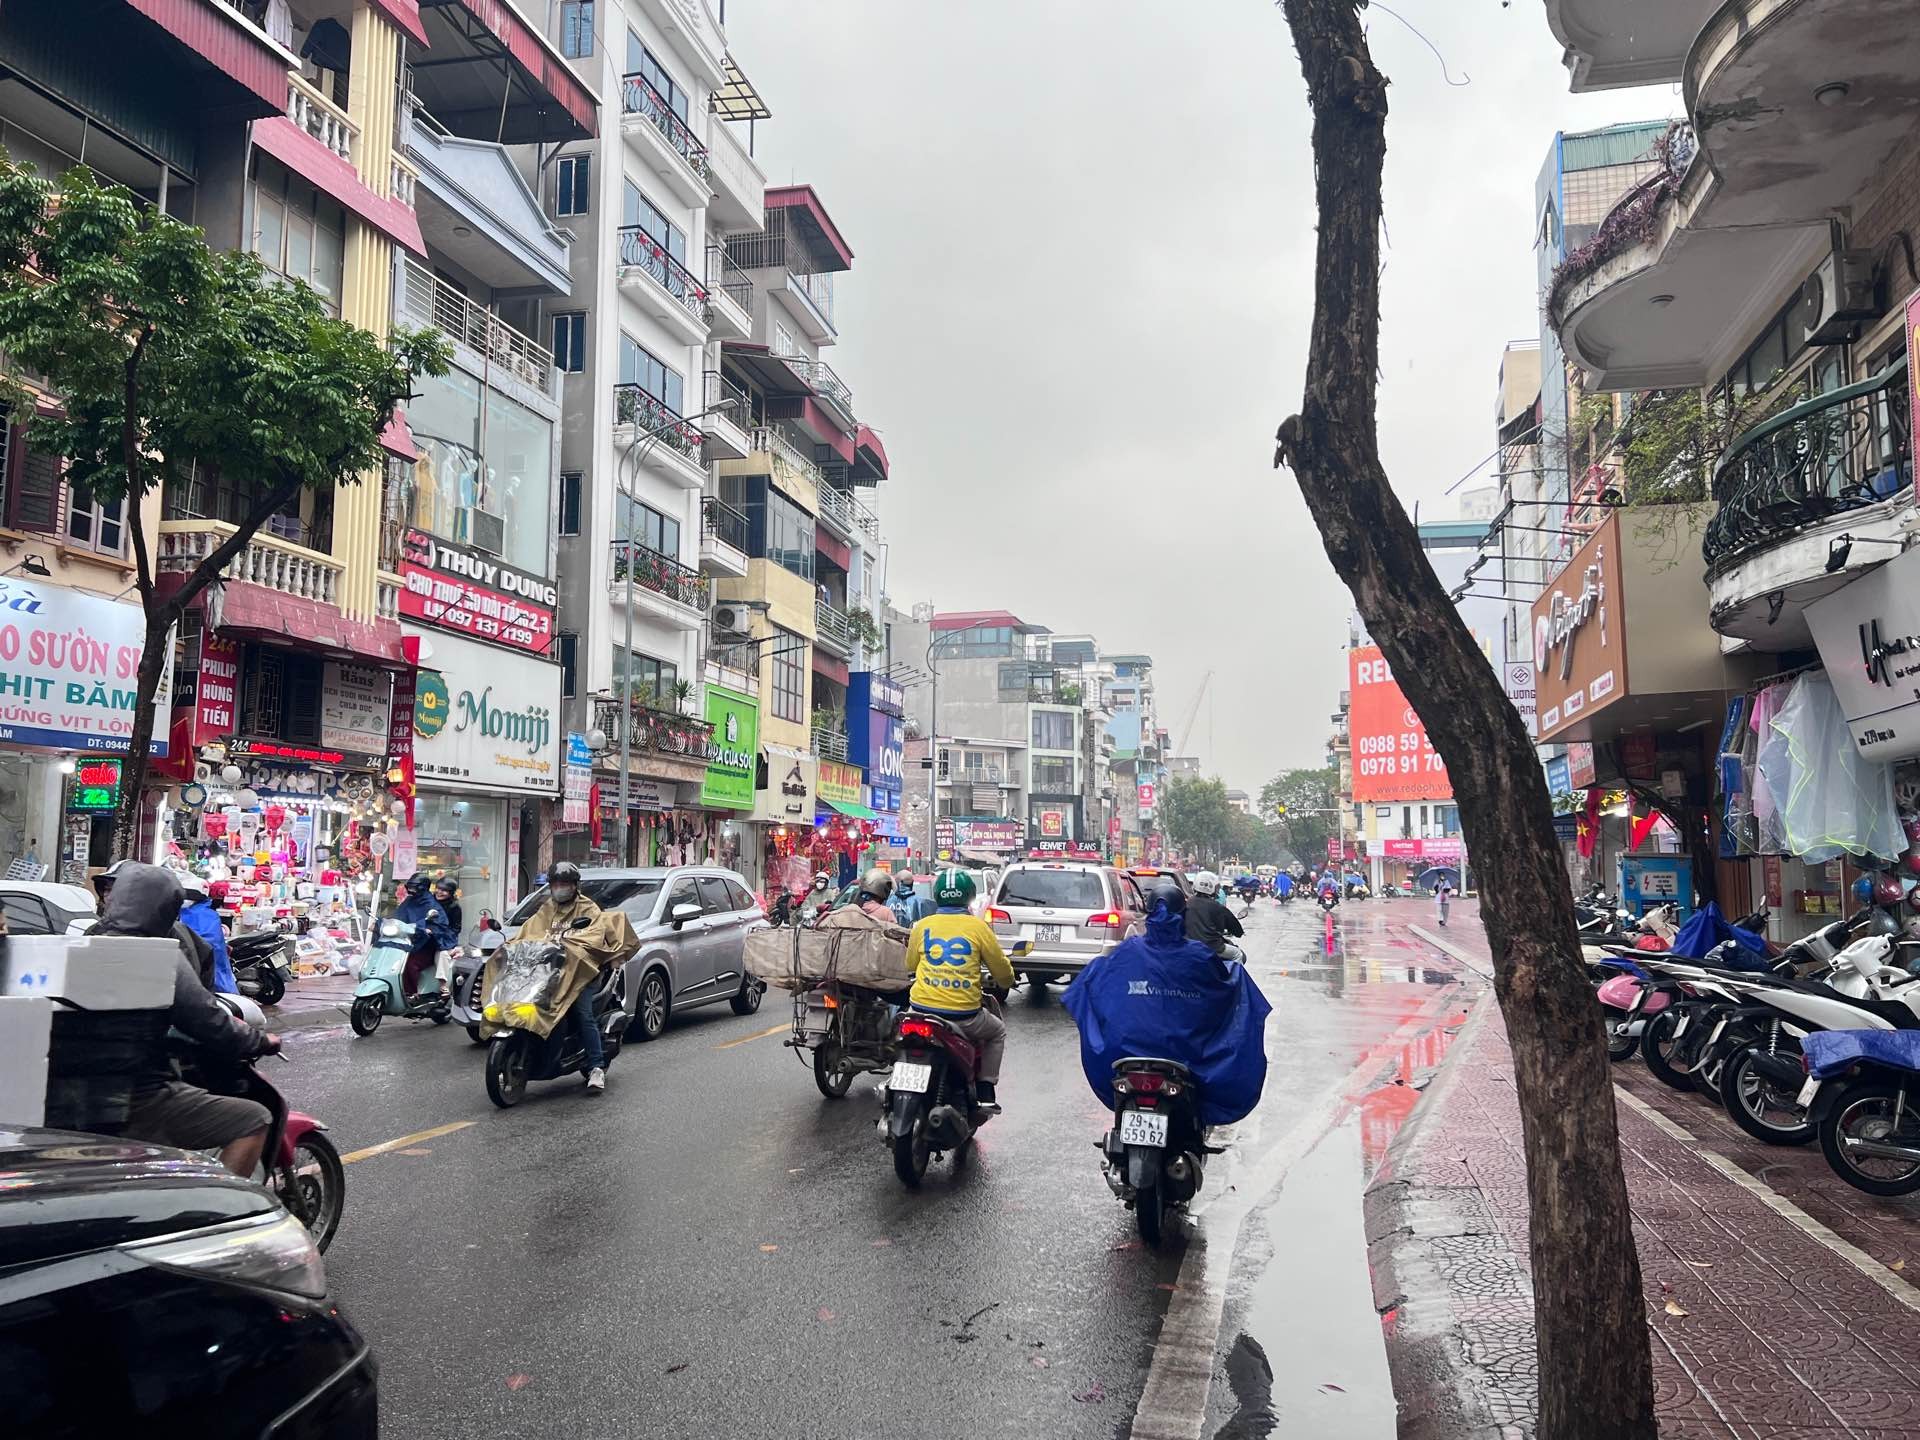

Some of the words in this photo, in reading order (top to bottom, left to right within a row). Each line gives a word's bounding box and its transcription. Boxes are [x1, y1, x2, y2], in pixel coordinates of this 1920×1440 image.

[407, 571, 432, 597] CHO
[437, 547, 498, 585] THÙY
[500, 570, 557, 606] DUNG
[445, 608, 473, 627] 097
[474, 616, 499, 636] 131
[501, 625, 533, 645] 1199
[202, 658, 237, 679] PHILIP
[66, 680, 137, 711] BĂM
[203, 680, 233, 703] HÙNG
[60, 715, 92, 731] VỊT
[203, 704, 229, 727] TIẾN
[454, 685, 549, 755] Momiji
[231, 739, 250, 752] 244
[389, 743, 410, 754] 244
[1360, 735, 1395, 755] 0988
[1400, 733, 1419, 751] 59
[80, 762, 117, 785] CHÁO
[366, 757, 382, 768] 244
[1360, 756, 1396, 775] 0978
[1400, 754, 1419, 773] 91
[1424, 752, 1443, 772] 70
[1039, 841, 1066, 850] GENVIET
[1077, 842, 1097, 851] JEANS
[940, 889, 963, 898] Grab
[923, 928, 972, 966] be
[1124, 1128, 1164, 1145] 559.62
